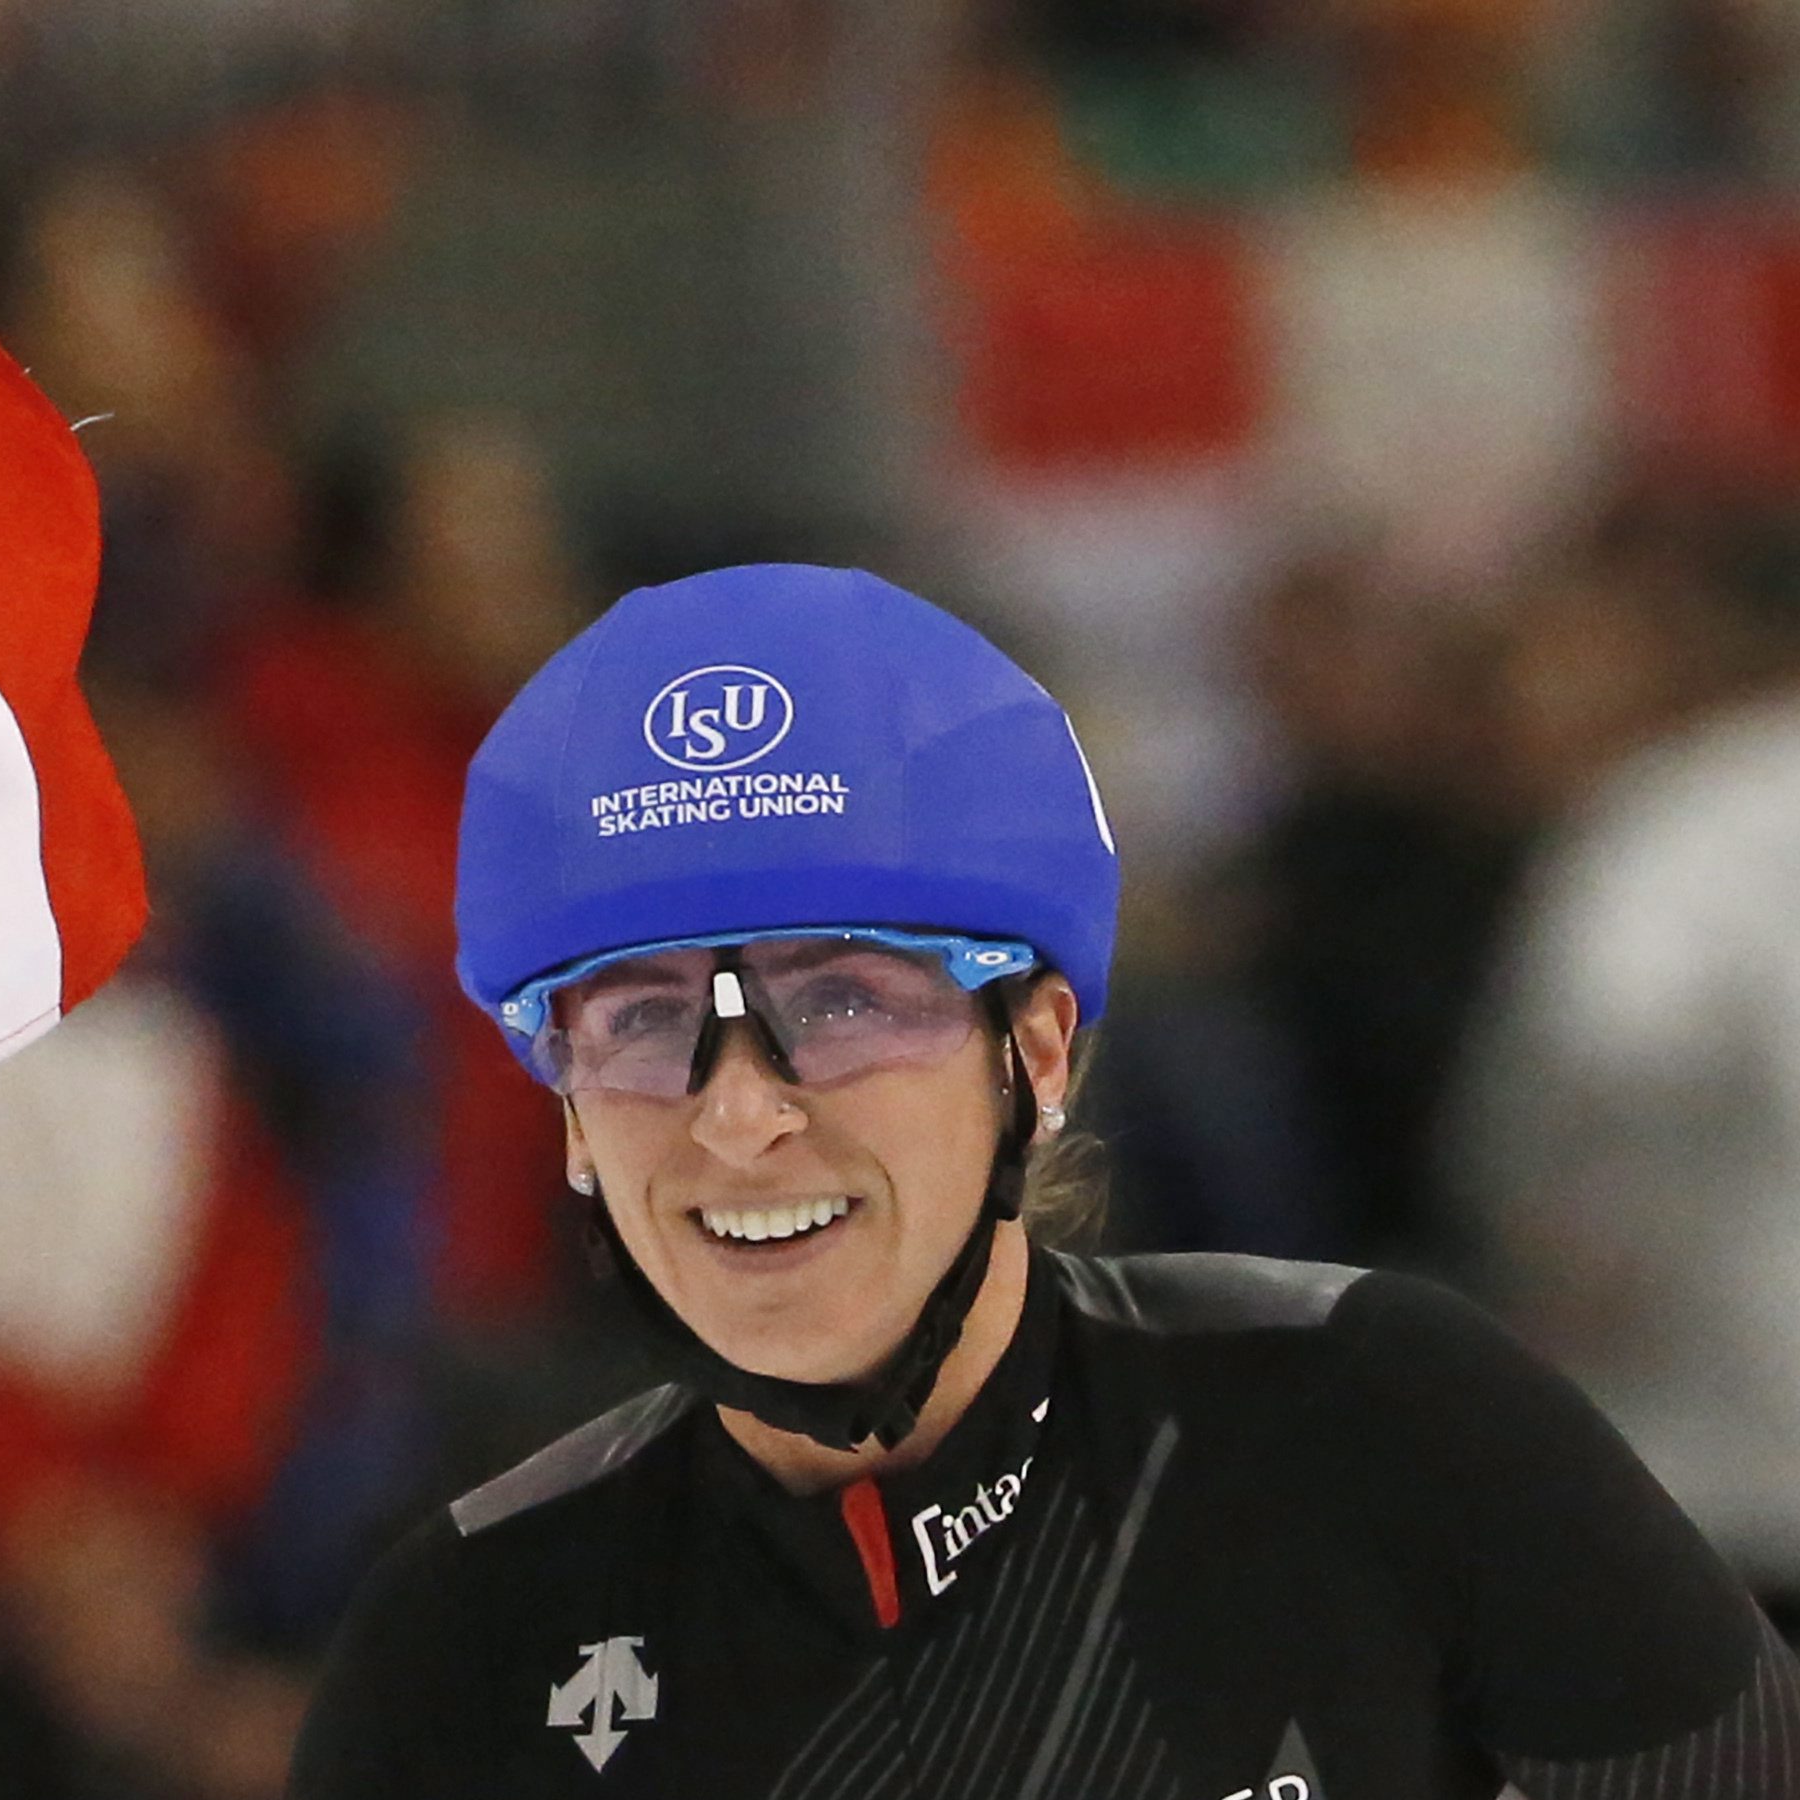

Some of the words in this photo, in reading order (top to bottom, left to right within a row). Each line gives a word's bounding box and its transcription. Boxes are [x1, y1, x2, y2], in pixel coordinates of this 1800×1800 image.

[667, 684, 770, 759] ISU
[591, 773, 850, 817] INTERNATIONAL
[598, 799, 731, 837] SKATING
[739, 794, 845, 819] UNION
